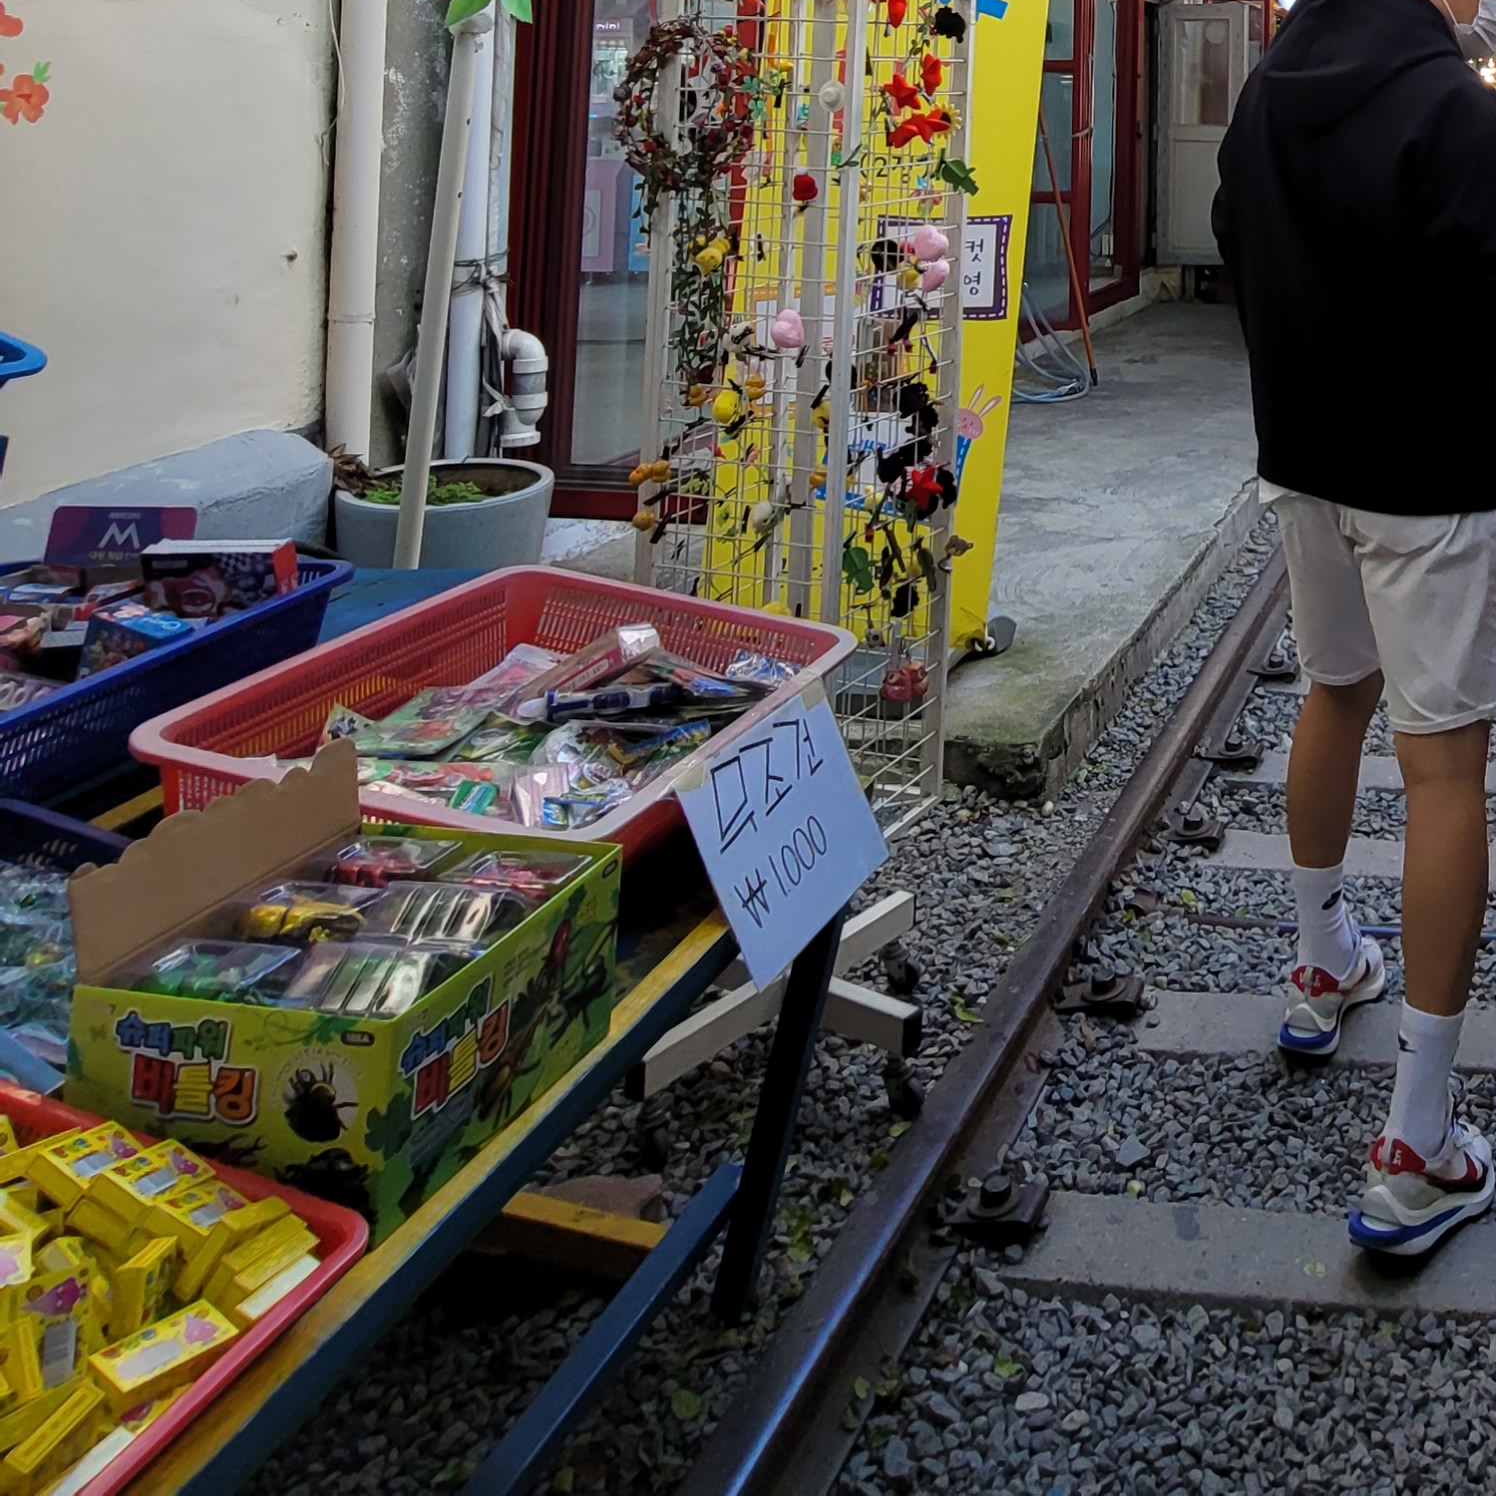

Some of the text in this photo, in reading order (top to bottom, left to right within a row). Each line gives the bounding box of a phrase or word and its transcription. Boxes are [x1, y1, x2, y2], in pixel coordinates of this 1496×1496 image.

[710, 718, 824, 855] 무조건
[115, 1010, 230, 1060] 슈퍼파워
[132, 1053, 256, 1121] 비틀킹
